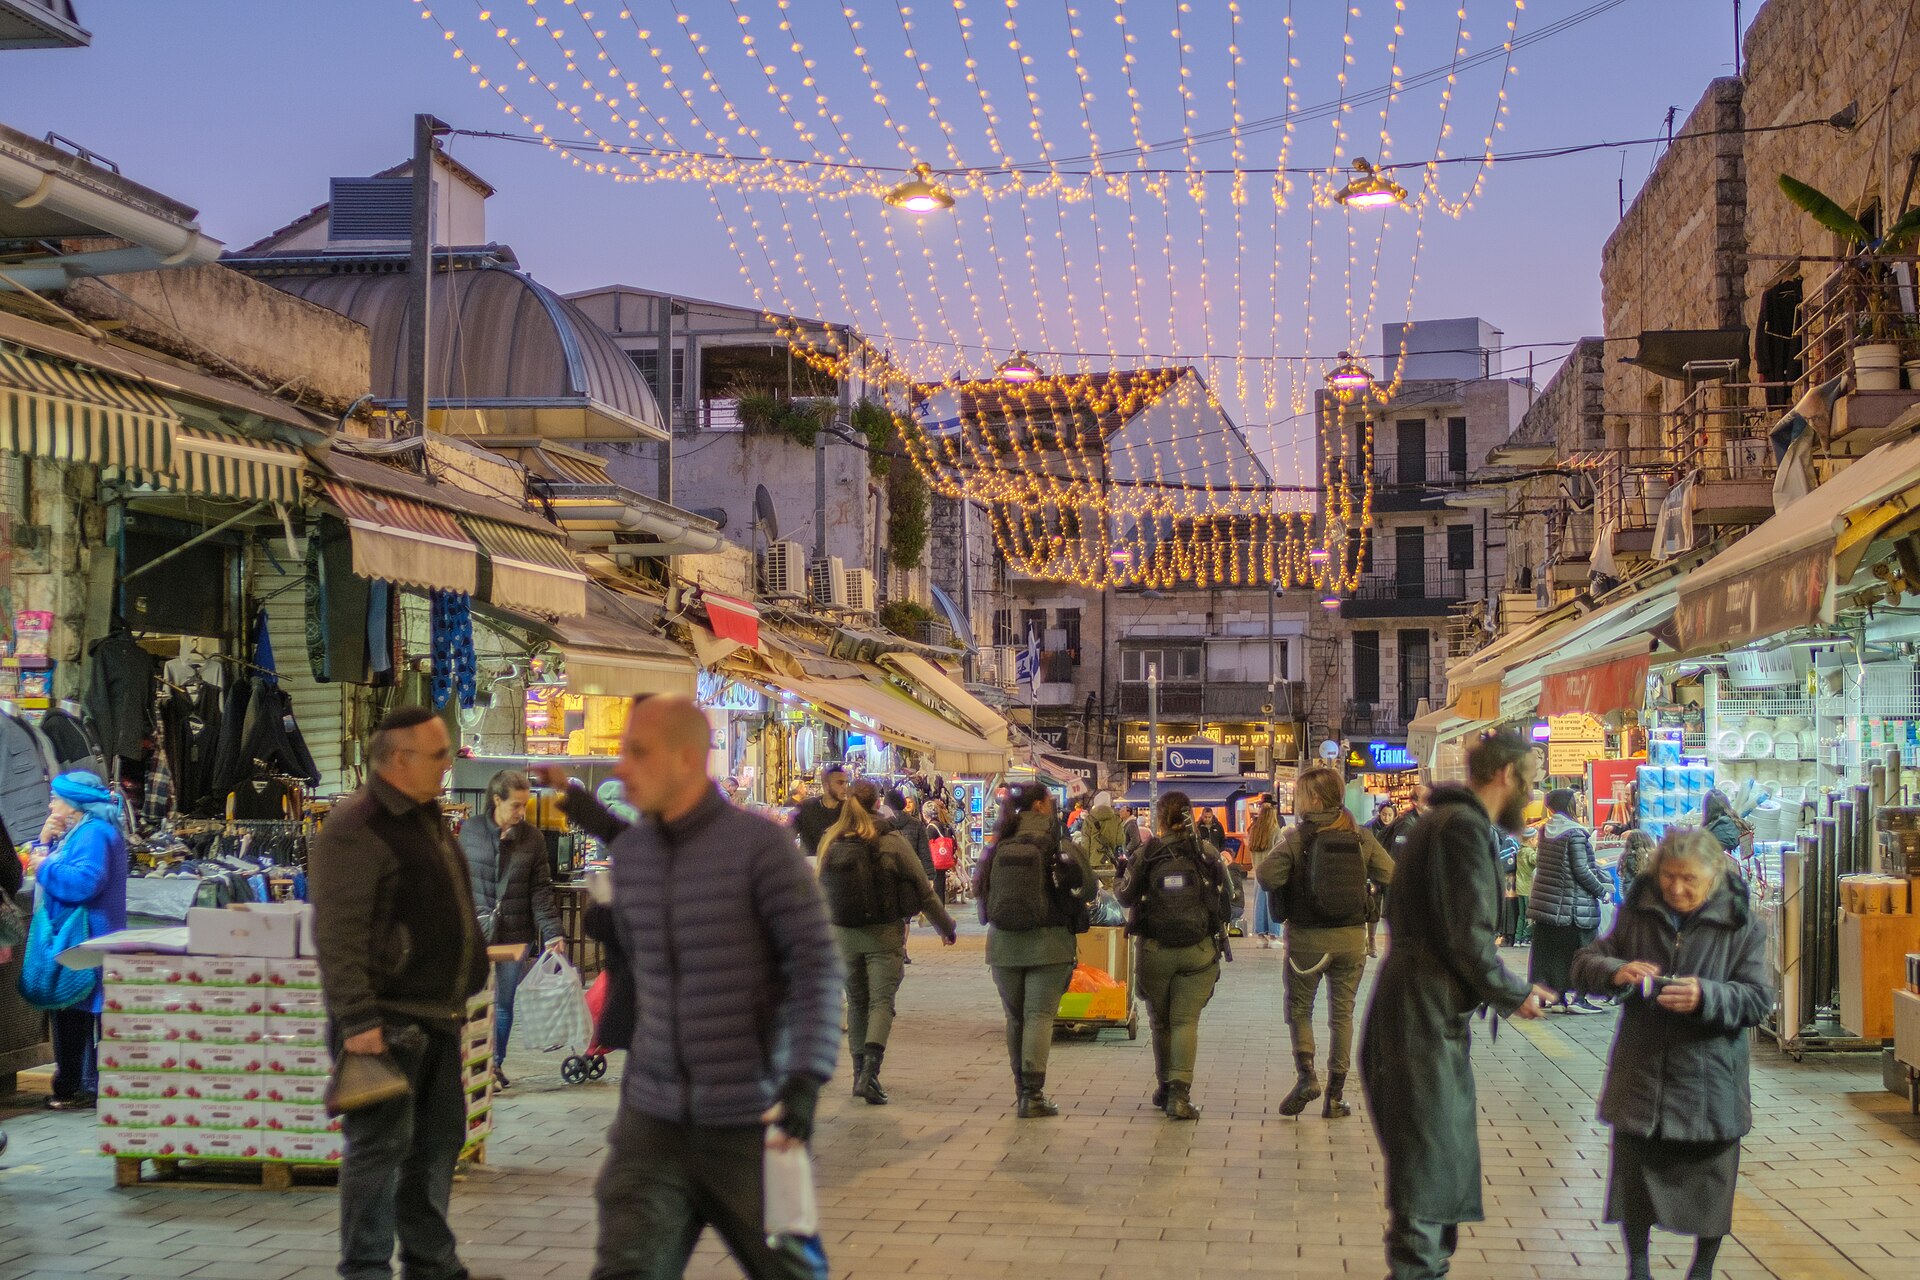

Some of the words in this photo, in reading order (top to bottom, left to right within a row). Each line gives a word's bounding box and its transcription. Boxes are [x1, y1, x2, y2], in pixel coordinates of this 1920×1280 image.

[1125, 735, 1165, 744] ENGLH
[1251, 734, 1294, 744] אינליש
[1370, 744, 1416, 765] TERMI
